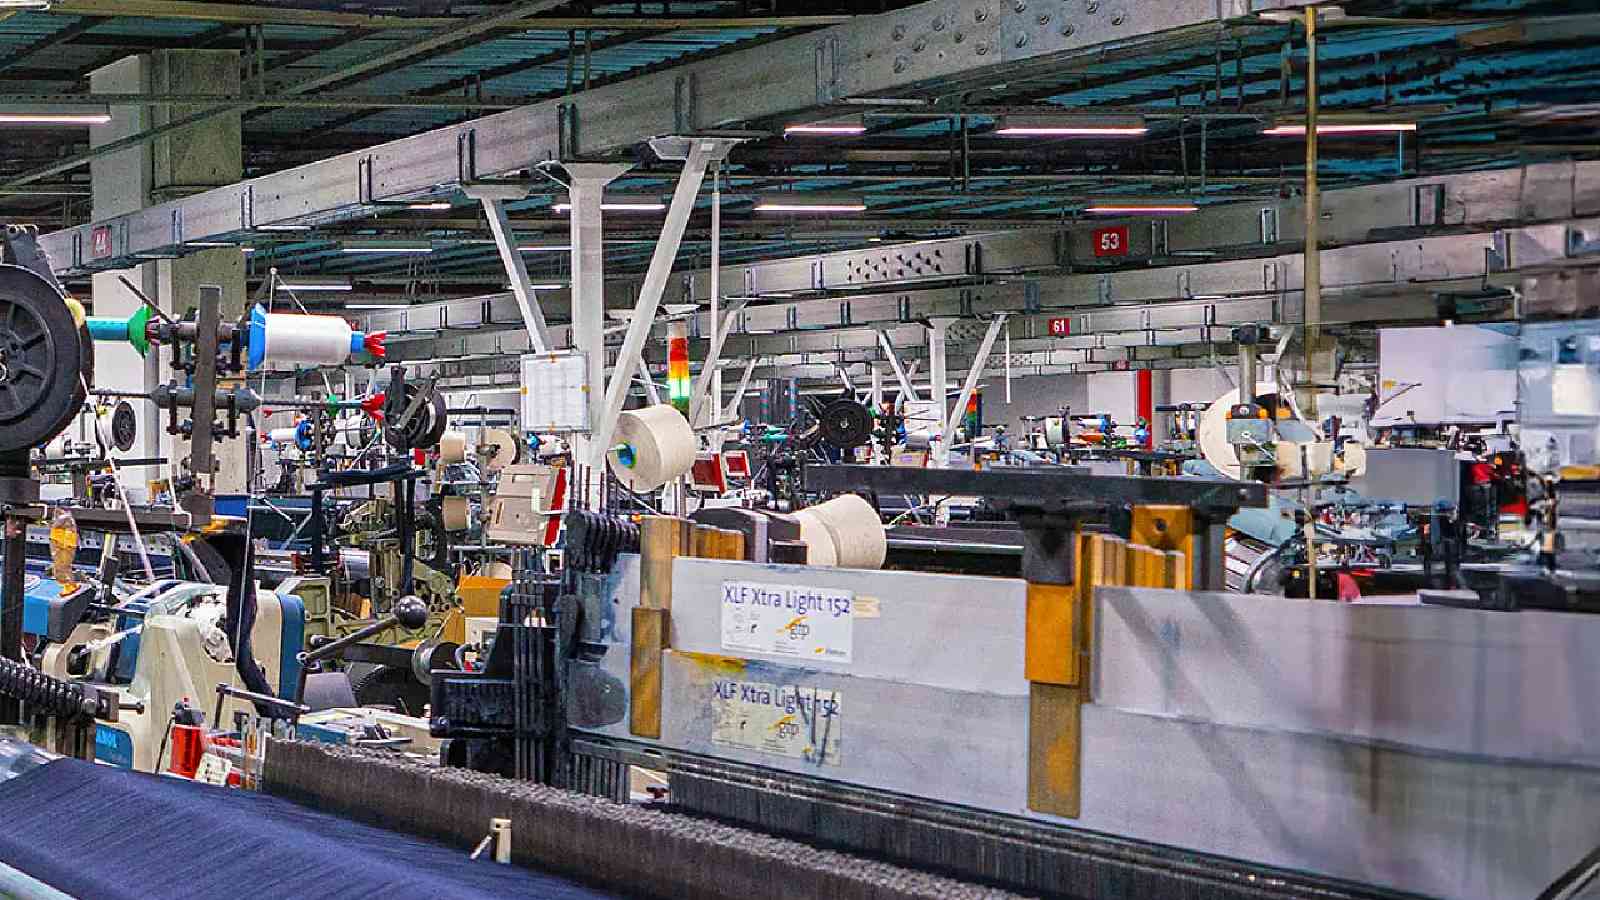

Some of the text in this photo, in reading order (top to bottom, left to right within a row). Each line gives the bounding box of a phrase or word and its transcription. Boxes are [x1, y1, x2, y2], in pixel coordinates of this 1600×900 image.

[1101, 232, 1120, 250] 53
[1054, 320, 1065, 332] 61
[723, 584, 749, 604] XLF
[751, 587, 782, 608] Xtra
[786, 590, 823, 615] Light
[827, 597, 851, 618] 152
[713, 681, 738, 700] XLF
[741, 683, 771, 705] Xtra
[776, 685, 812, 715] Light
